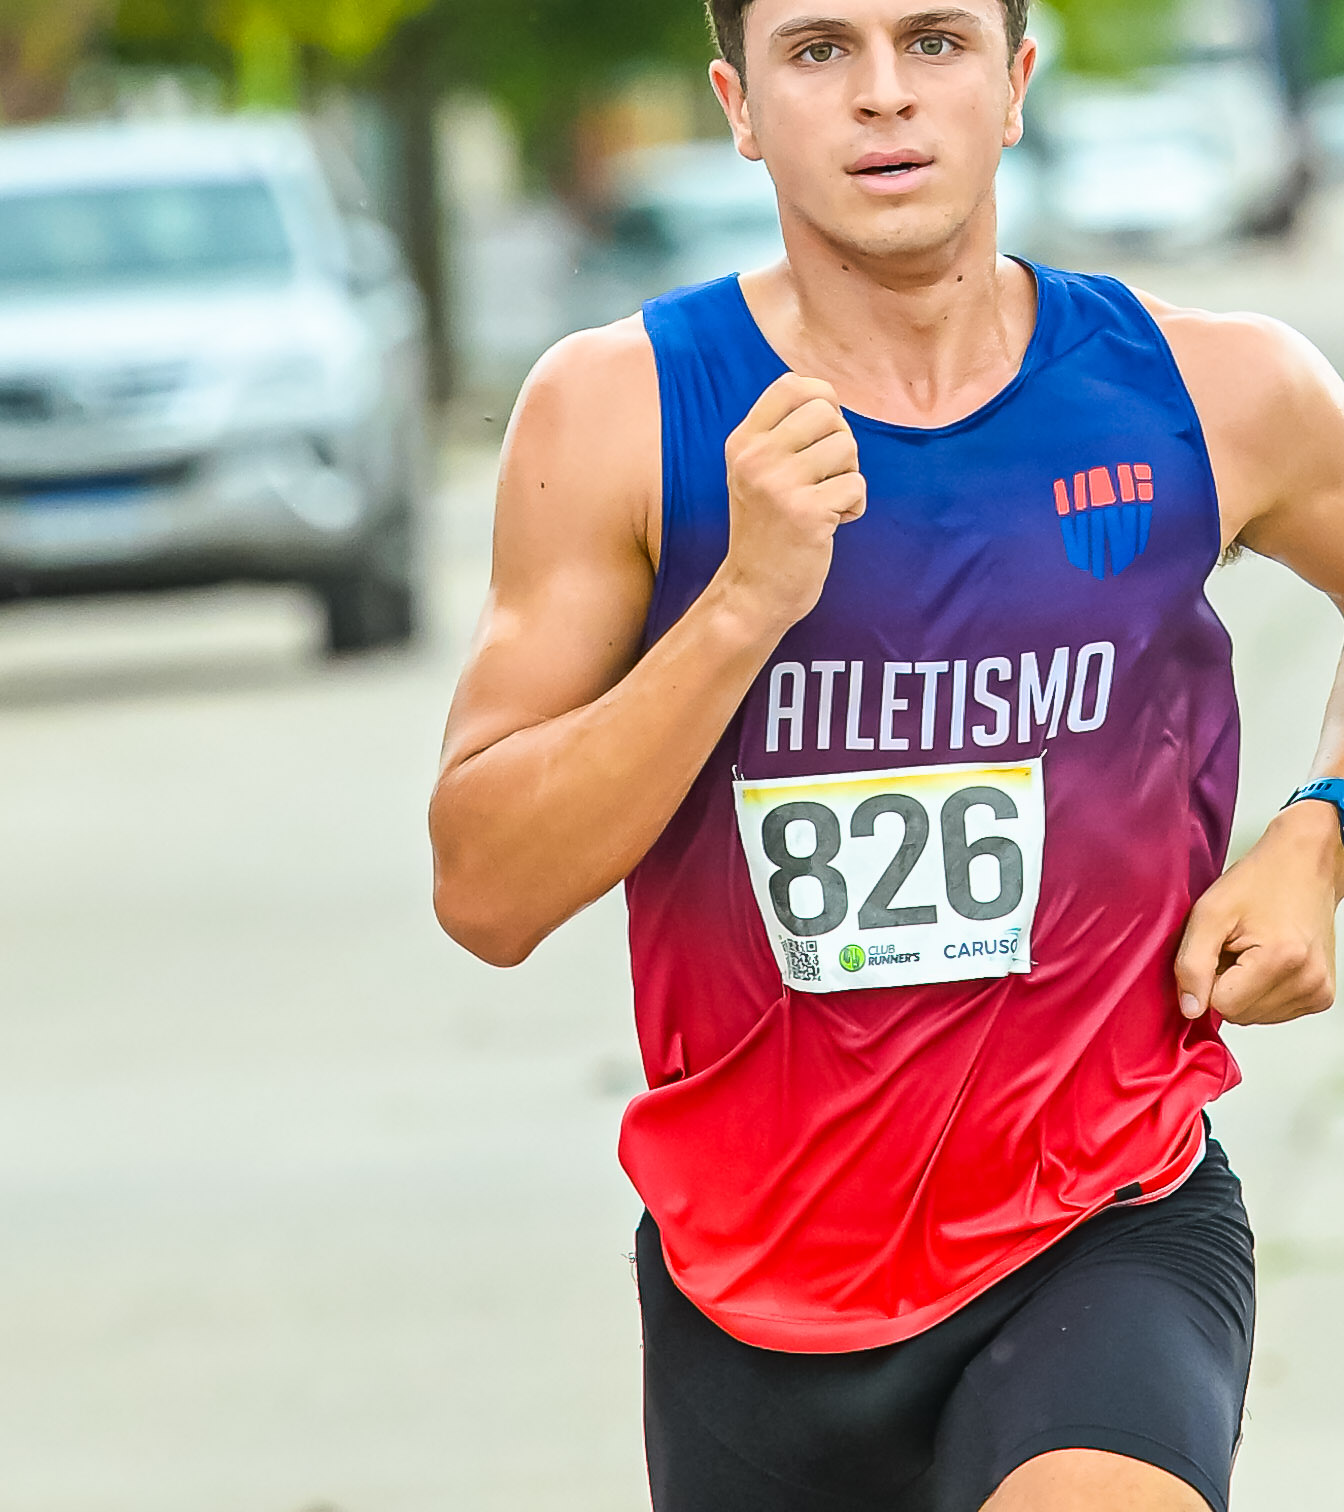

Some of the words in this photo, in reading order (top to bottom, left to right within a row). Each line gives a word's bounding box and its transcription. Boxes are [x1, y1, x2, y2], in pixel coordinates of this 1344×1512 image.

[766, 641, 1116, 752] ATLETISMO
[761, 785, 1024, 937] 826
[868, 944, 896, 955] CLUB
